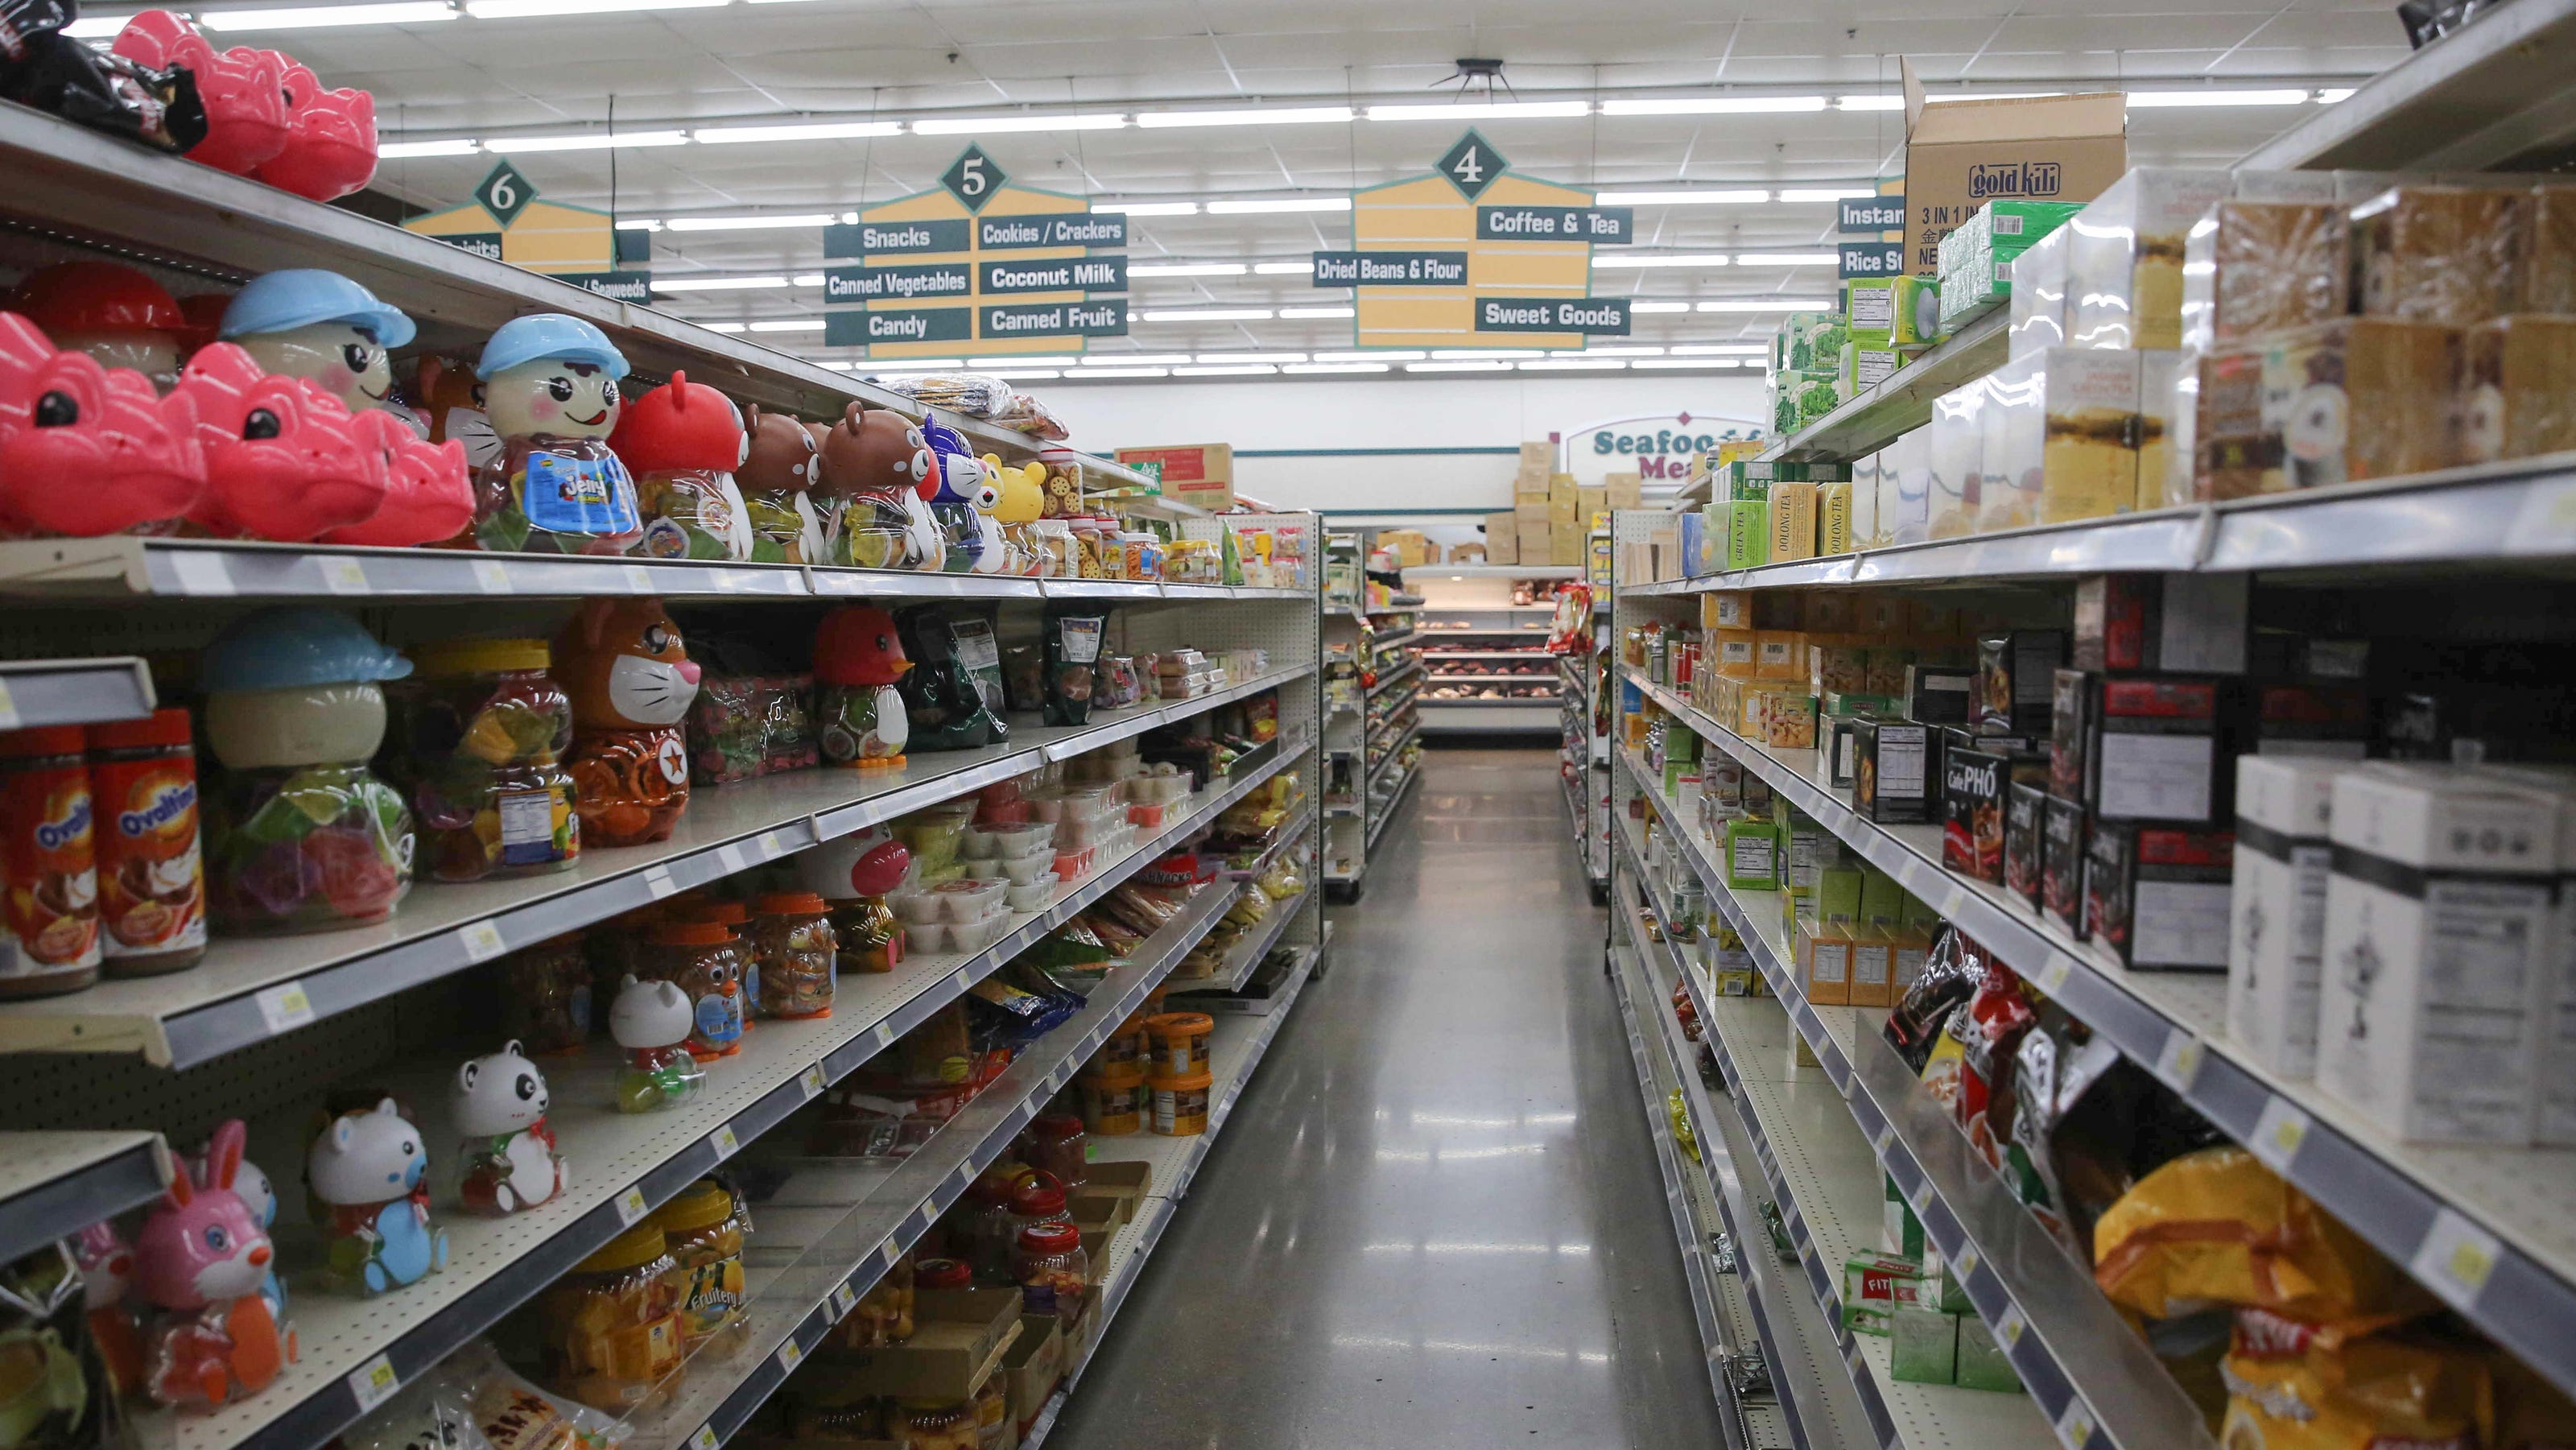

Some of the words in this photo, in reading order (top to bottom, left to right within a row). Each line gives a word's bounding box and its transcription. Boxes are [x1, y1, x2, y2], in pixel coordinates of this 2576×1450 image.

[962, 156, 986, 196] 5
[1454, 145, 1483, 184] 4
[490, 172, 515, 209] 6
[1973, 164, 2017, 196] gold
[2021, 162, 2055, 196] kili
[1489, 211, 1554, 234] Coffee
[1563, 211, 1579, 234] &
[1587, 213, 1620, 235] Tea
[1922, 207, 1930, 225] 3
[1934, 206, 1948, 224] IN
[1953, 205, 1959, 223] 1
[863, 227, 931, 248] Snacks
[983, 223, 1038, 244] Cookies
[1042, 221, 1052, 244] /
[1055, 221, 1122, 241] Crackers
[1318, 258, 1357, 280] Dried
[1360, 259, 1405, 280] Beans
[1409, 258, 1422, 279] &
[1424, 258, 1463, 279] Flour
[1845, 250, 1881, 271] Rice
[828, 275, 882, 295] Canned
[885, 271, 966, 298] Vegetables
[991, 267, 1069, 288] Coconut
[1073, 263, 1116, 284] Milk
[869, 314, 927, 337] Candy
[991, 309, 1061, 331] Canned
[1067, 307, 1116, 328] Fruit
[1484, 303, 1550, 325] Sweet
[1558, 304, 1621, 326] Goods
[1594, 430, 1736, 454] Seafoo
[1834, 495, 1843, 513] TEA
[1736, 510, 1744, 526] TEA
[1736, 529, 1745, 561] GREEN
[1778, 514, 1790, 552] OOLONG
[1831, 514, 1842, 555] OOLONG
[691, 1287, 737, 1310] Fruitery
